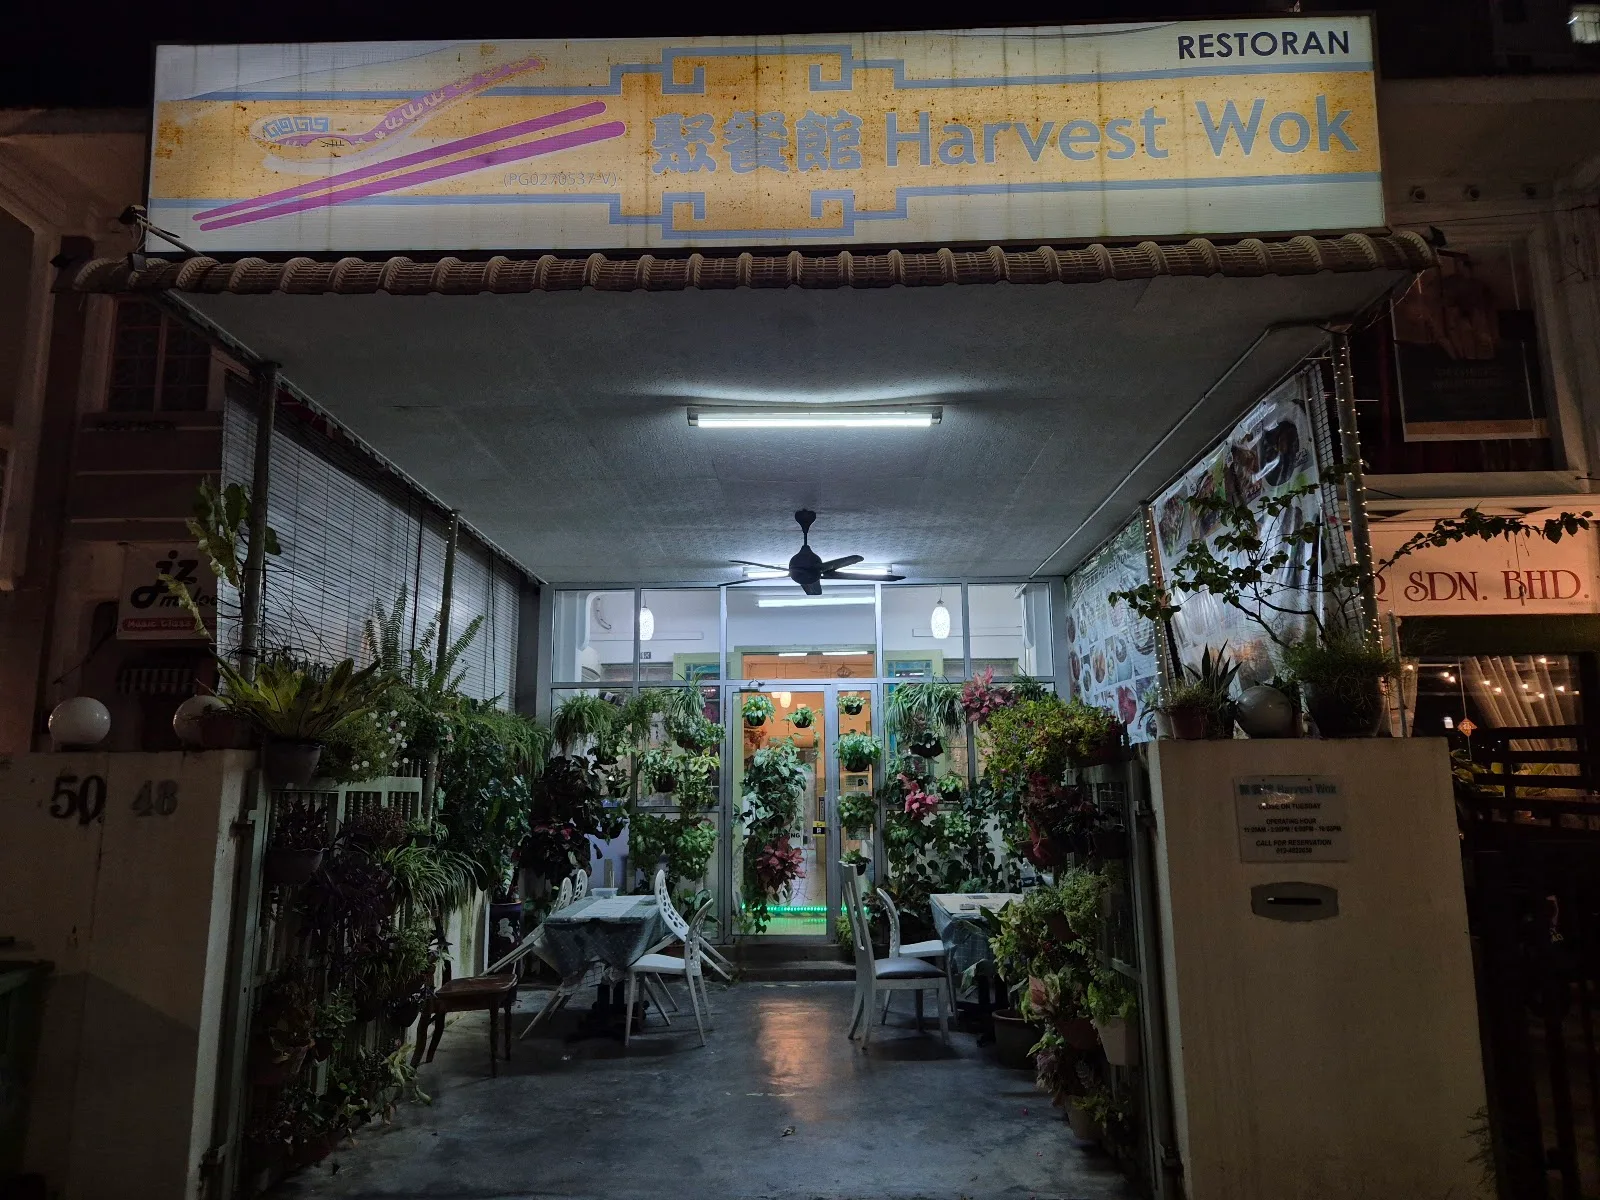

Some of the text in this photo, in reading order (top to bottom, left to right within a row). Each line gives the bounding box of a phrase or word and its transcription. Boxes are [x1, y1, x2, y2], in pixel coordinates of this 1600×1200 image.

[1177, 31, 1350, 59] RESTORAN
[650, 108, 864, 174] 聚餐館
[885, 94, 1360, 168] Harvest Wok
[1404, 570, 1488, 602] SDN.
[1500, 570, 1590, 600] BHD.
[50, 774, 108, 822] 50
[1280, 802, 1291, 810] ON
